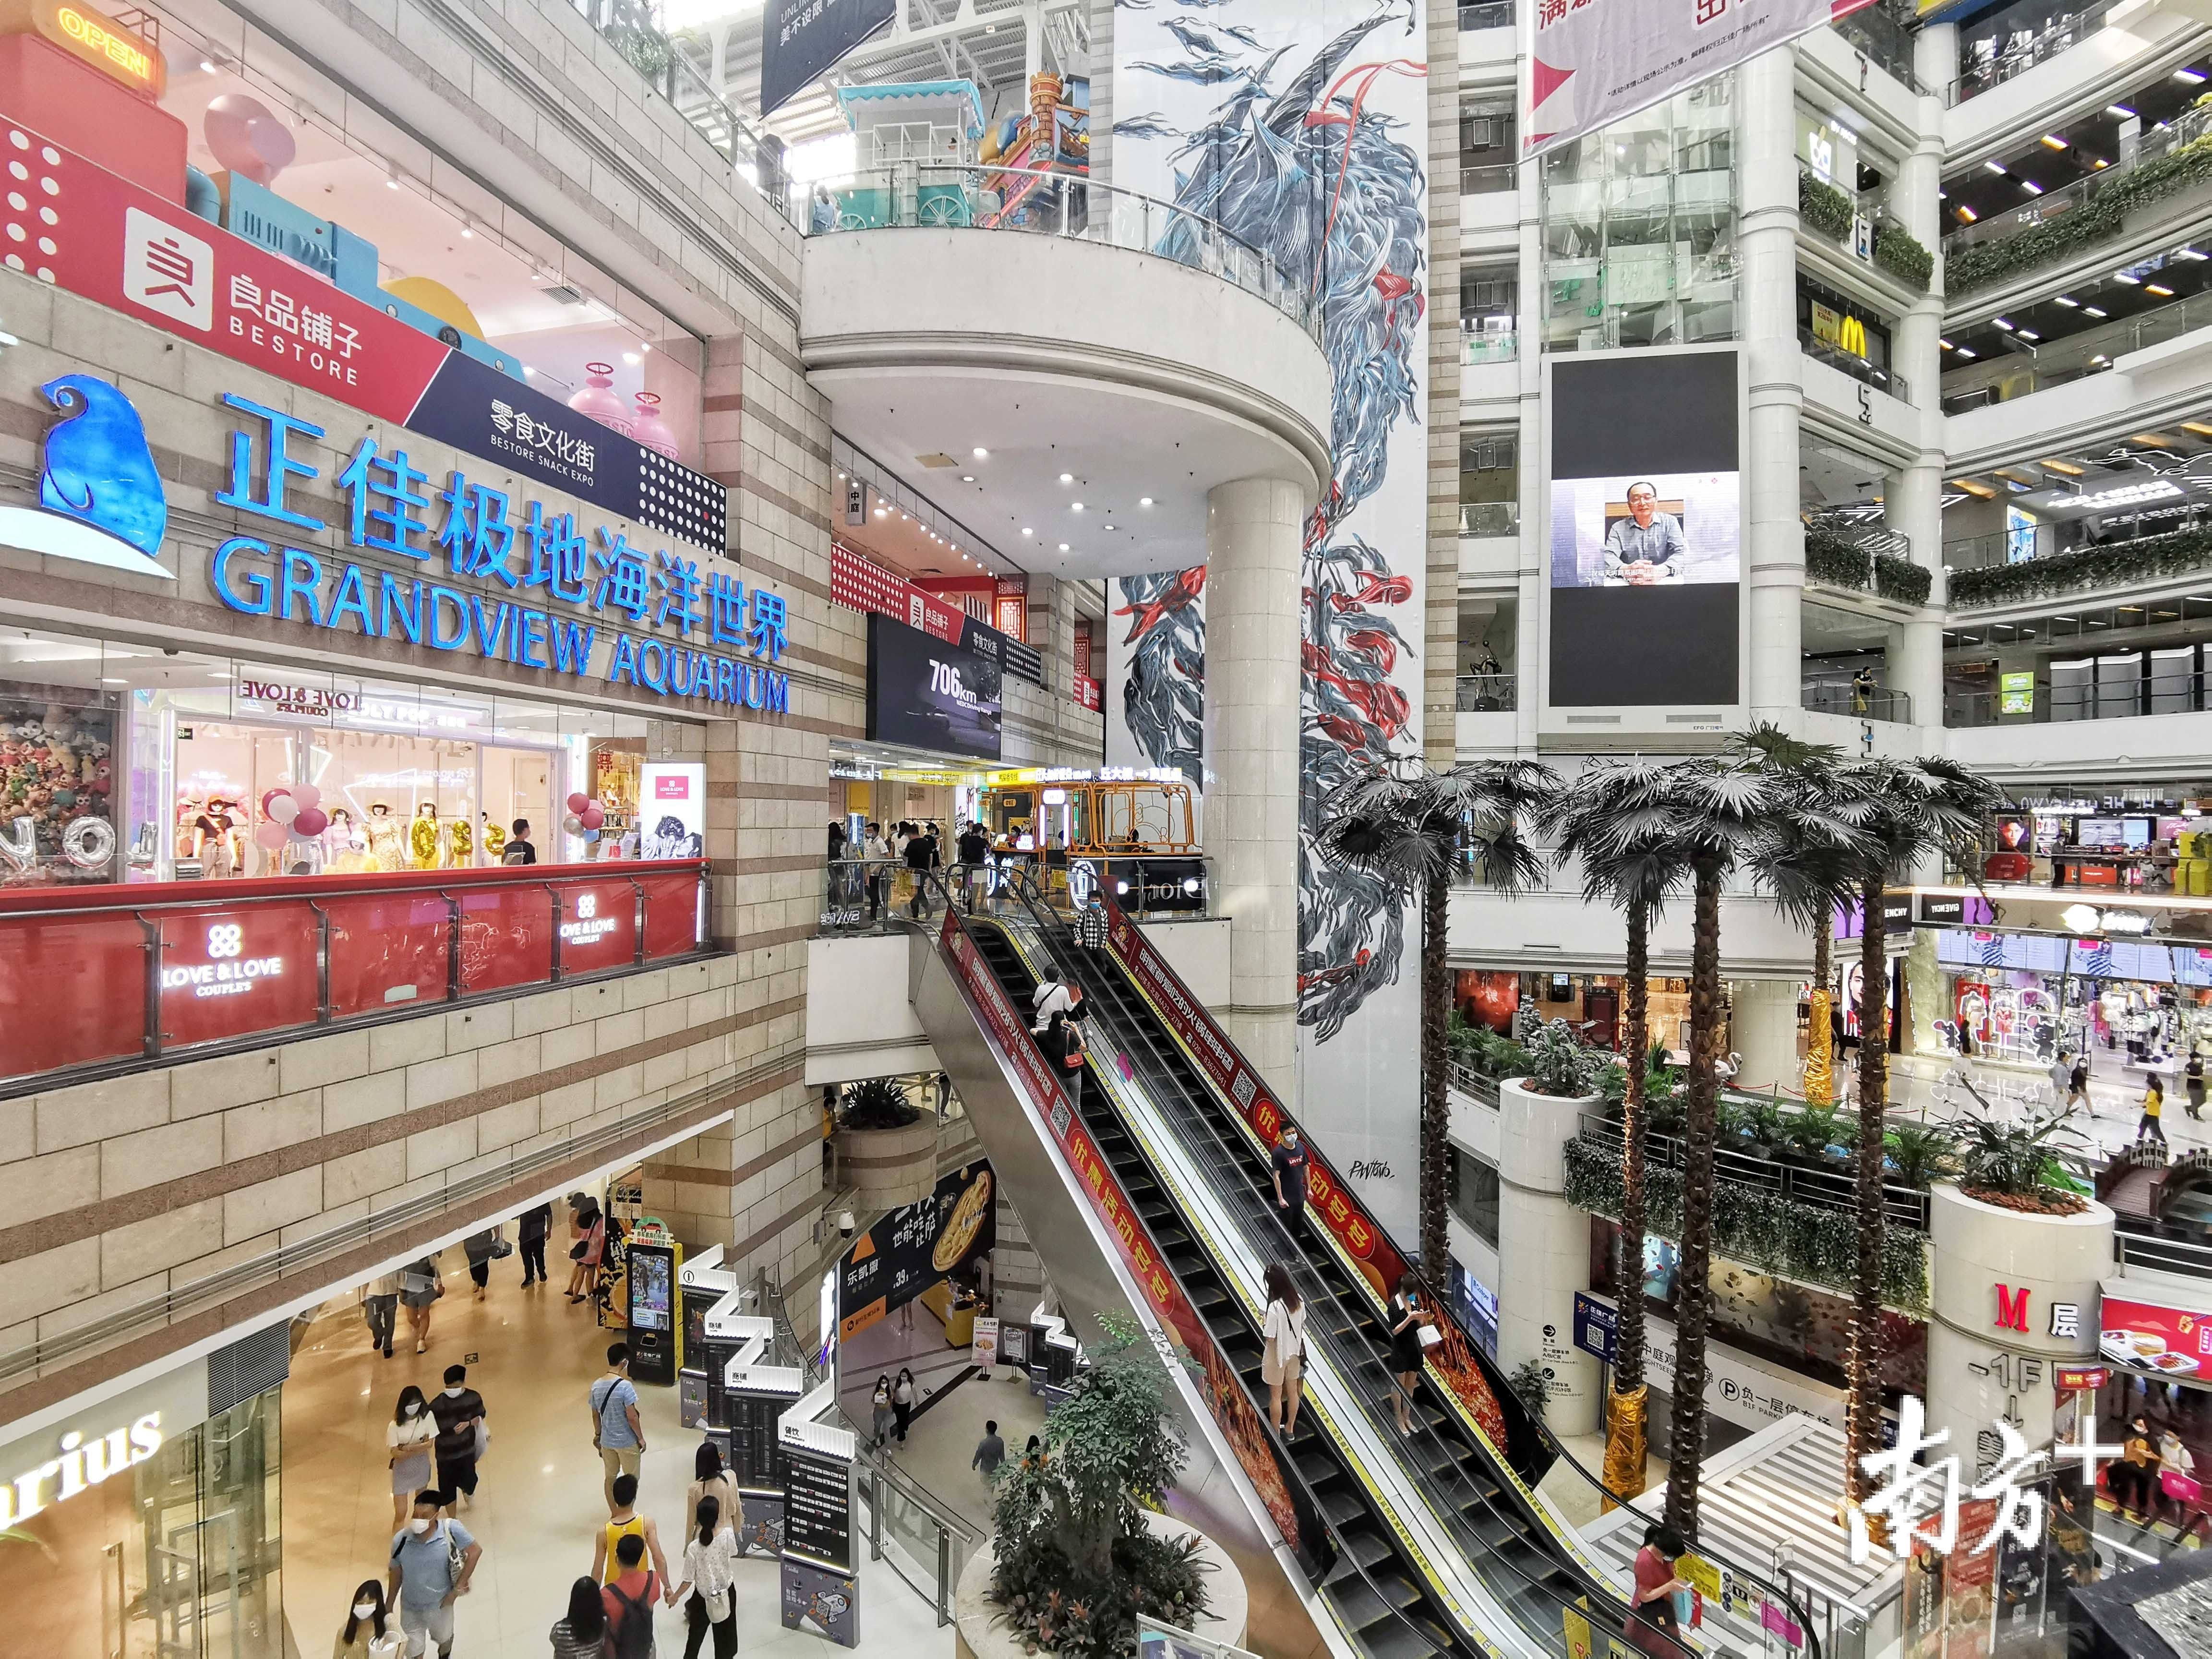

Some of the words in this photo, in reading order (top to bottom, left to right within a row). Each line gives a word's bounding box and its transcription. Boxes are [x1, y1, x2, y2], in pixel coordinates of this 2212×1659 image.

[59, 7, 152, 80] OPEN
[780, 1, 822, 46] 美不设限
[230, 274, 362, 359] 良品铺子
[229, 315, 358, 386] BESTORE
[490, 398, 595, 473] 零食文化街
[491, 434, 535, 462] BESTORE
[538, 456, 568, 476] SNACK
[571, 470, 594, 487] EXPO
[215, 391, 789, 661] 正佳极地海洋世界
[850, 491, 860, 513] 中庭
[212, 537, 596, 677] GRANDVIEW
[611, 633, 790, 715] AQUARIUM
[925, 607, 949, 631] 良品铺子
[560, 923, 581, 938] OVE
[591, 918, 615, 933] LOVE
[1885, 907, 1908, 918] ENCHY
[162, 965, 214, 988] LOVE
[216, 963, 232, 981] &
[233, 957, 281, 979] LOVE
[972, 957, 1052, 1096] 明星都爱吃的火锅串串香
[1139, 947, 1235, 1072] 明星都爱吃的火锅串串香
[708, 1322, 722, 1330] 商铺
[1994, 1283, 2031, 1333] M
[2048, 1302, 2080, 1338] 层
[732, 1372, 747, 1381] 商铺
[785, 1426, 799, 1437] 餐饮
